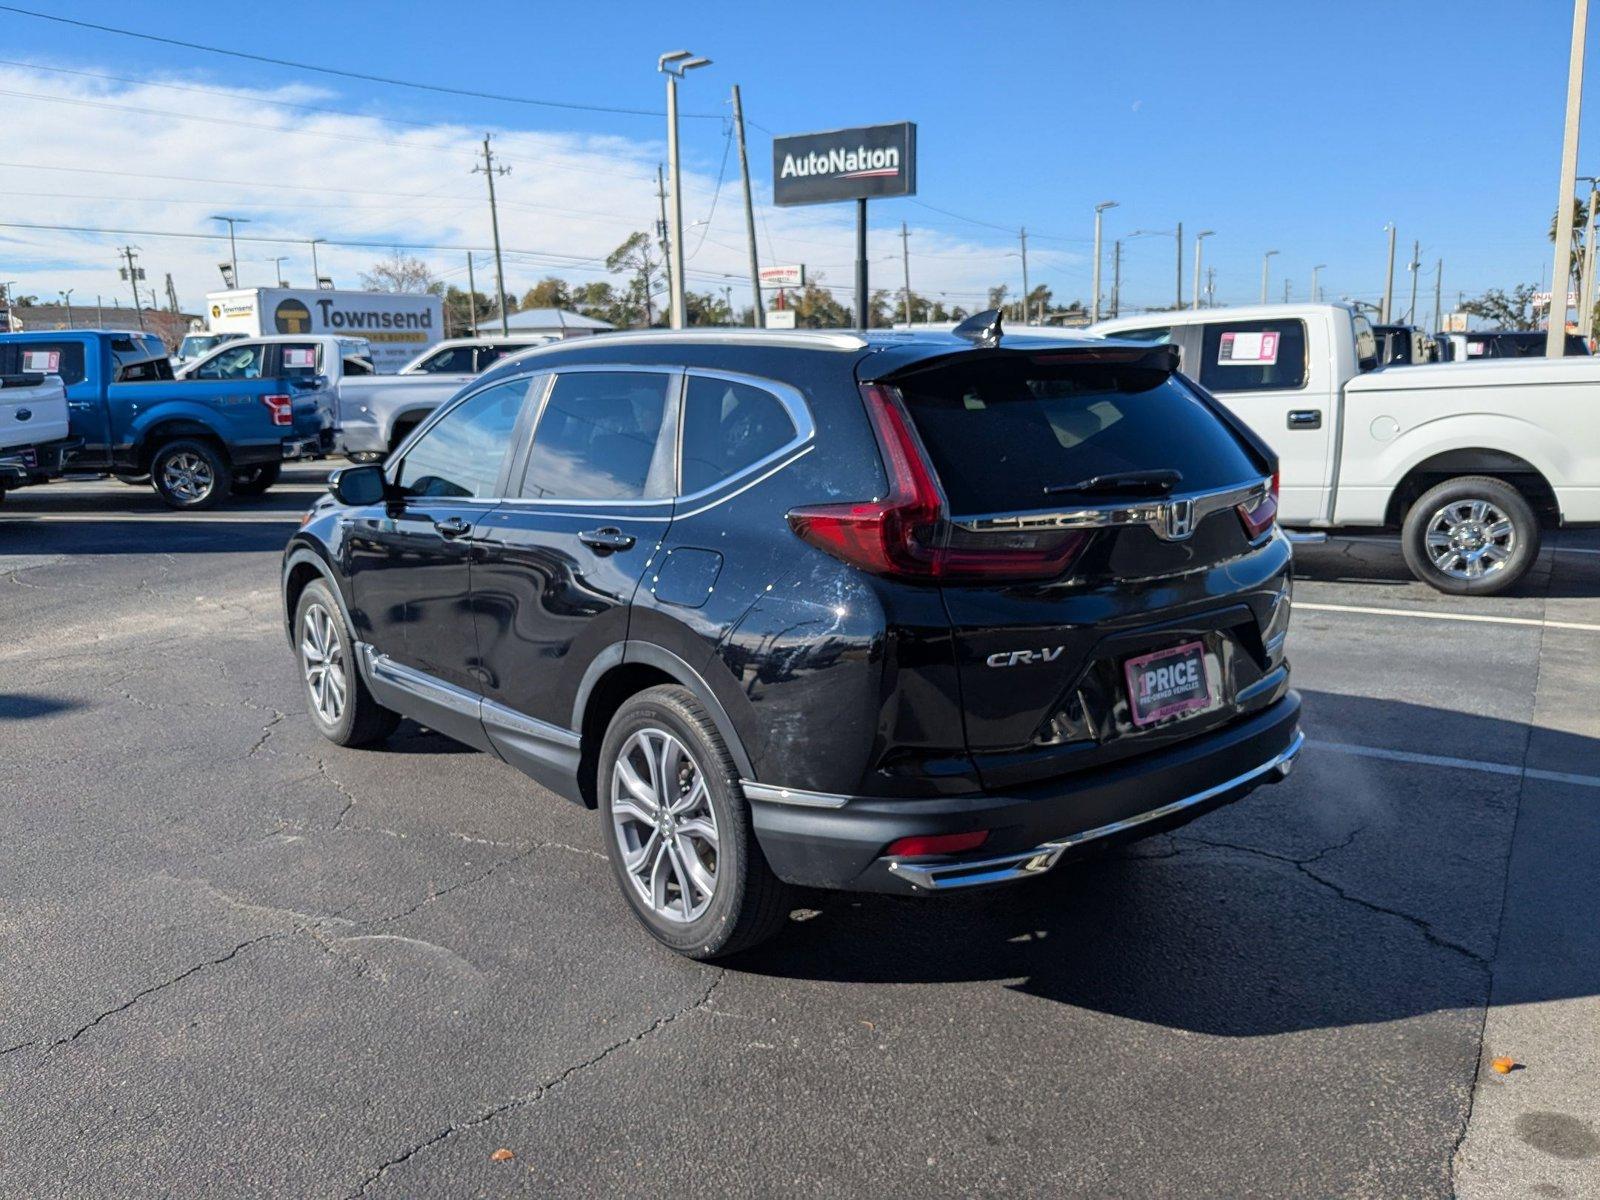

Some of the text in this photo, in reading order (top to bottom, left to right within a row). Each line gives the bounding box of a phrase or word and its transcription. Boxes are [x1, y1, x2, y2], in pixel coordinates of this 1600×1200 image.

[780, 145, 900, 178] AutoNation
[317, 299, 432, 329] Townsend
[986, 645, 1065, 668] CR-V
